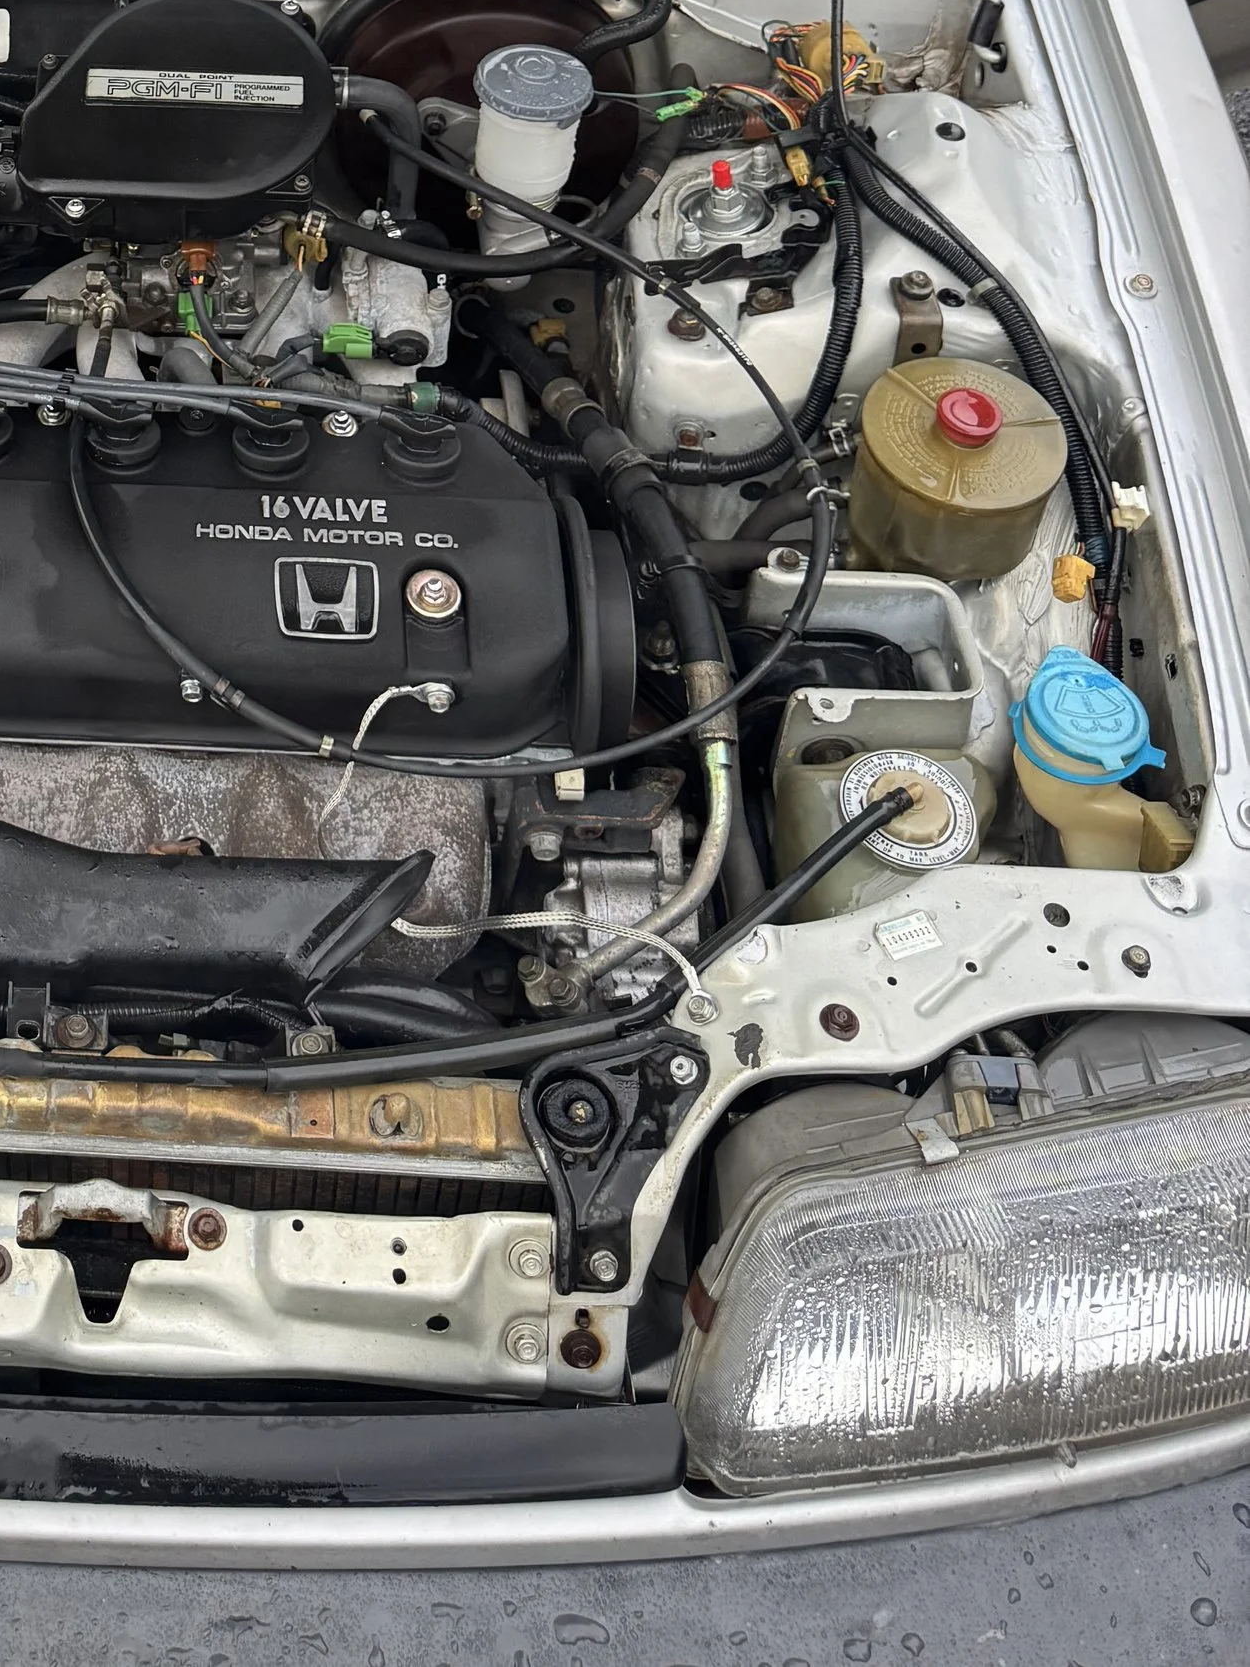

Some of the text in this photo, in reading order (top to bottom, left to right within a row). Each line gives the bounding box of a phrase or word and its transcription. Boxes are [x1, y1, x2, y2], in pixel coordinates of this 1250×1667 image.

[107, 79, 222, 100] PGM-FI
[234, 84, 291, 92] PROGRAMMED
[260, 495, 388, 523] 16 VALVE
[195, 523, 458, 549] HONDA MOTOR CO.
